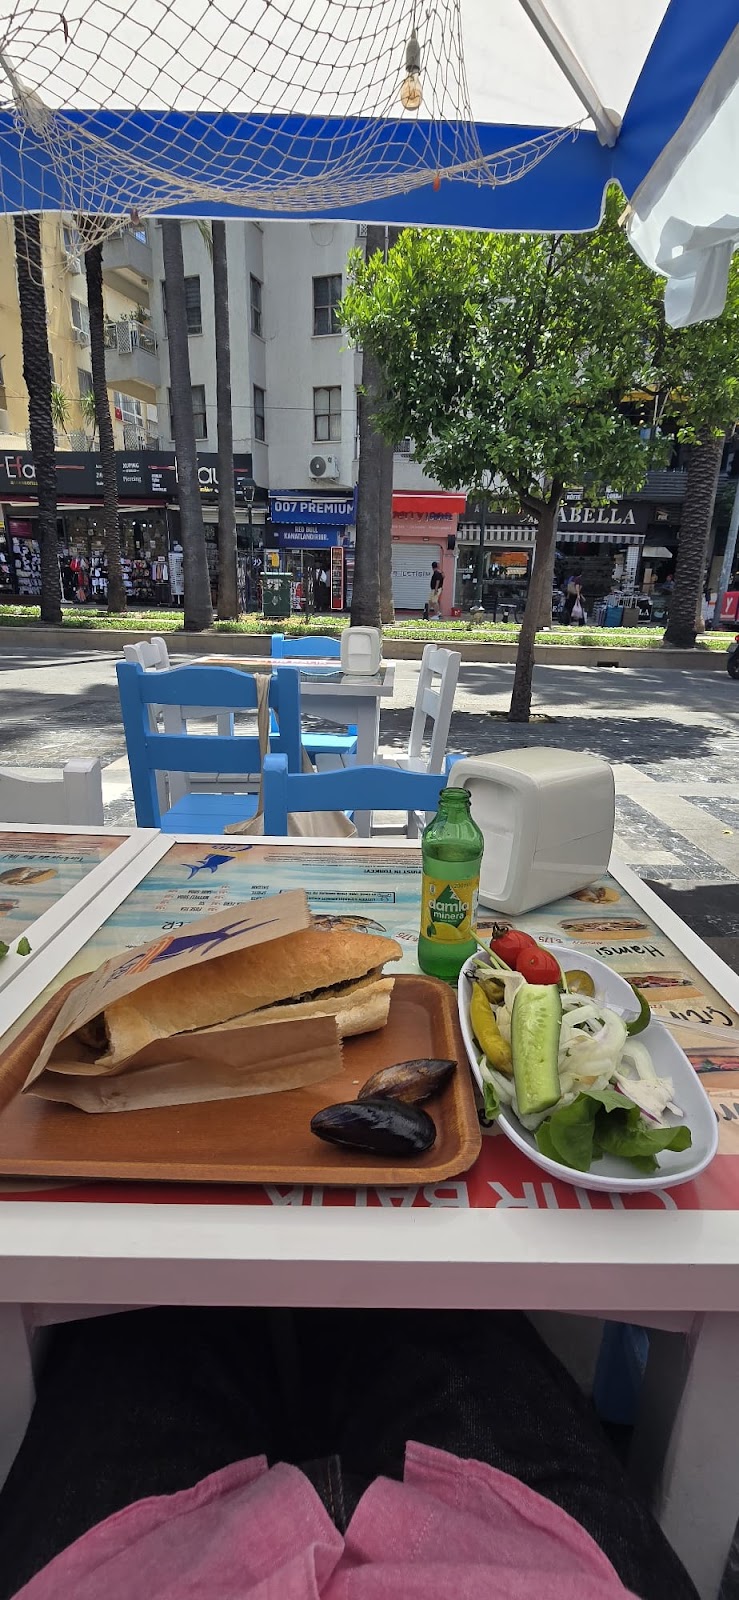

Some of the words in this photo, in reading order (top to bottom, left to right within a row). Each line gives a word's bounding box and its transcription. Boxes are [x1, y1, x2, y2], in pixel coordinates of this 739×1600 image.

[122, 475, 142, 483] Piercing
[274, 502, 298, 512] 007
[556, 507, 636, 525] ABELLA
[428, 898, 470, 912] damla
[433, 911, 465, 920] minera
[594, 944, 665, 959] Hamsi
